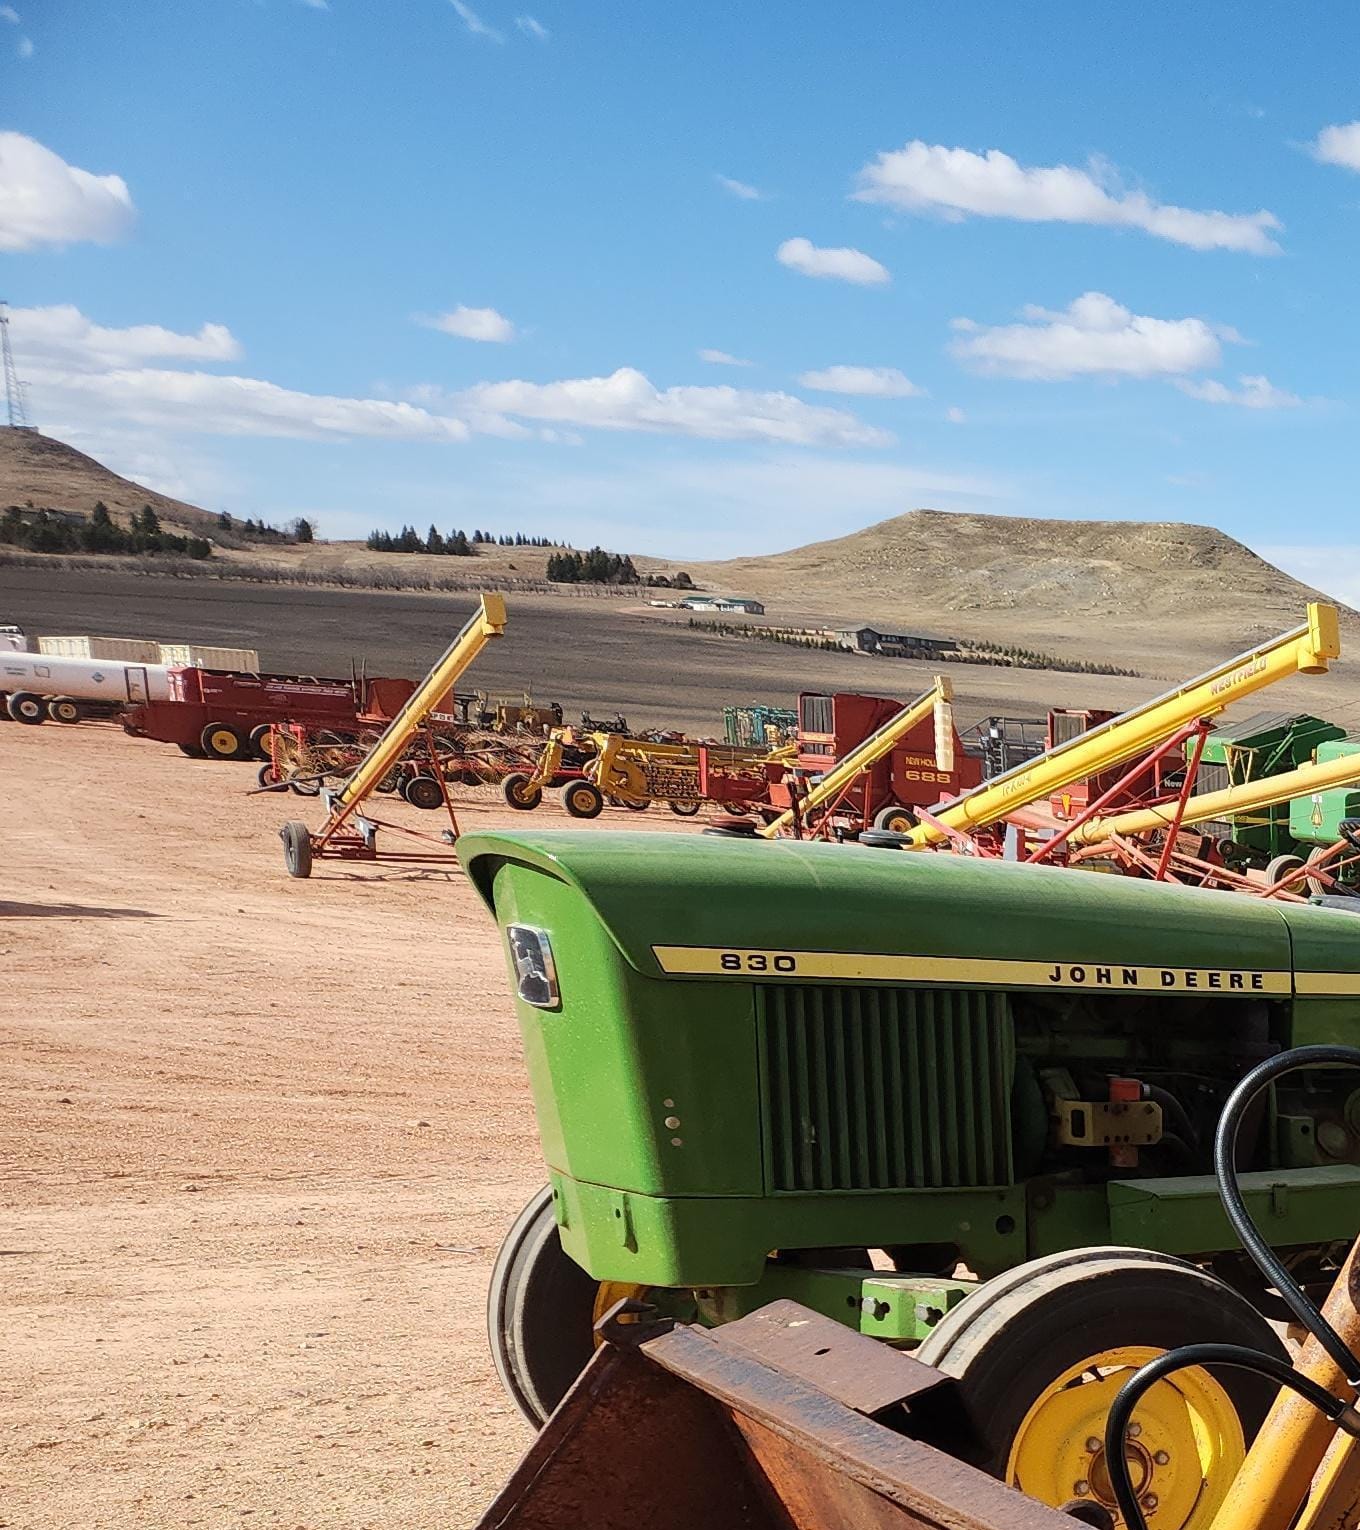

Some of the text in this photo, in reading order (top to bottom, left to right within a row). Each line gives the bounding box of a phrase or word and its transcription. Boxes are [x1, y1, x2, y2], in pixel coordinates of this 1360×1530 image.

[921, 758, 937, 768] HOLL
[905, 770, 951, 784] 688
[1163, 780, 1183, 788] New
[721, 953, 1264, 990] 830 JOHN DEERE
